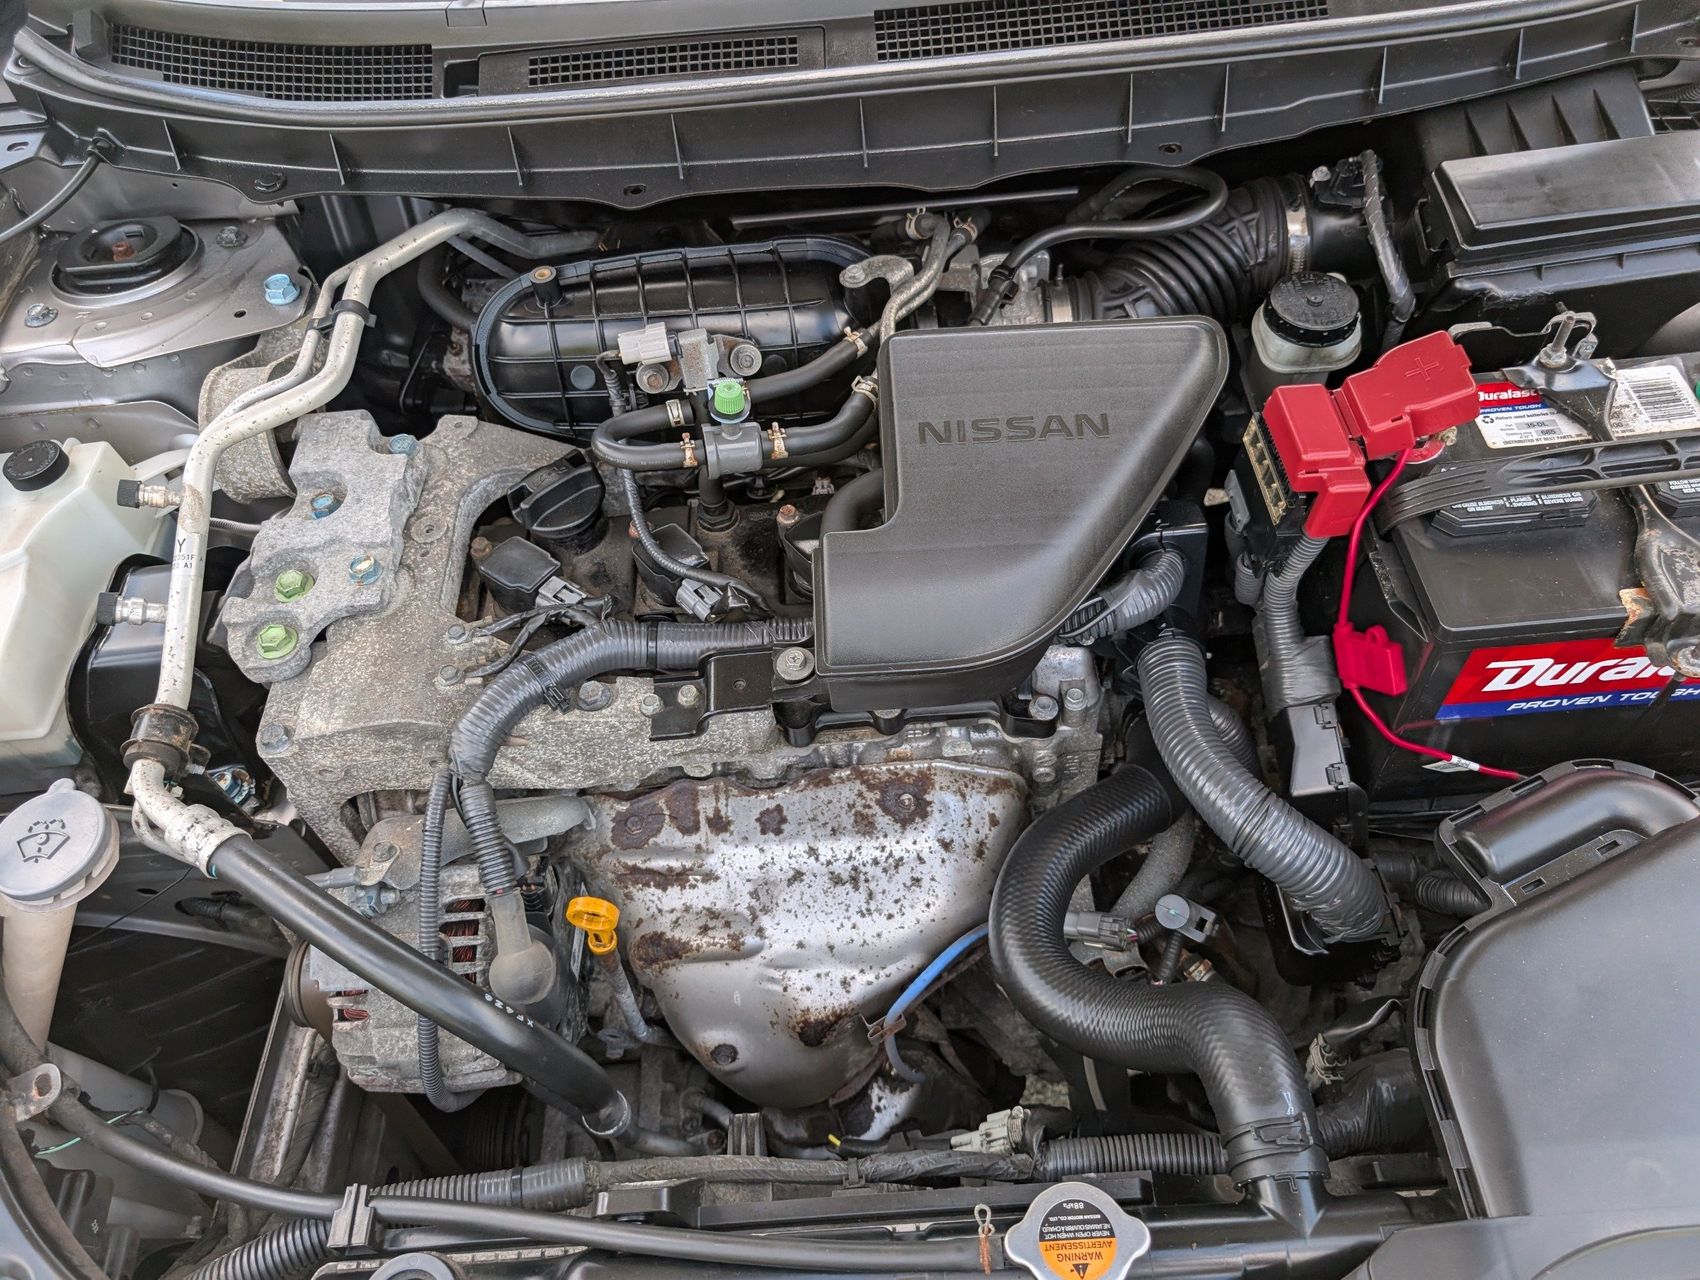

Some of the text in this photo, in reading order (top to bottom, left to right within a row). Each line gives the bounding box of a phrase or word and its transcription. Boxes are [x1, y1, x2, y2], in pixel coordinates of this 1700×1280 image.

[918, 412, 1110, 446] NISSAN
[177, 538, 186, 553] Y
[1507, 694, 1613, 711] PROVEN
[1044, 1240, 1112, 1252] AVERTISSEMENT
[1056, 1251, 1104, 1262] WARNING
